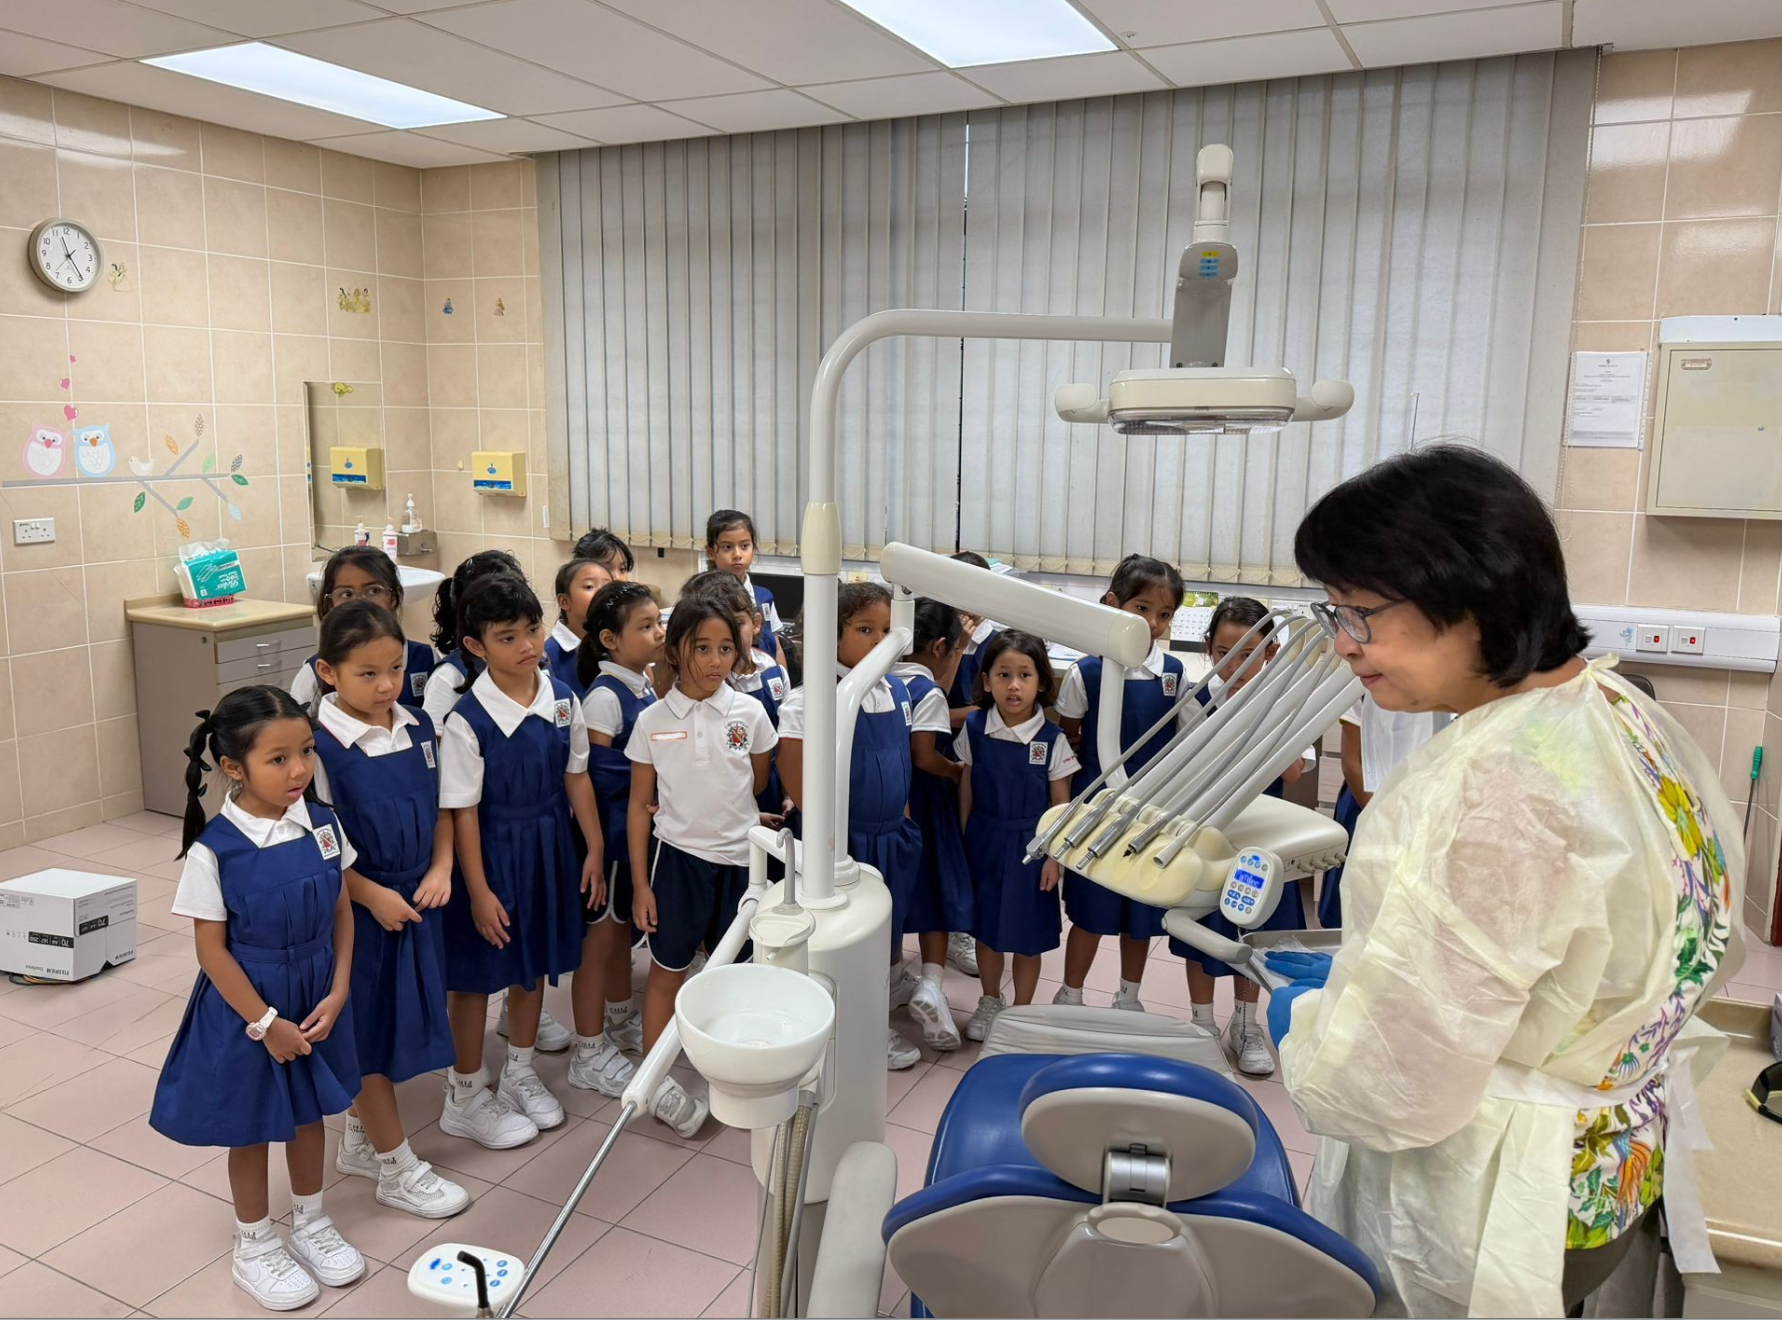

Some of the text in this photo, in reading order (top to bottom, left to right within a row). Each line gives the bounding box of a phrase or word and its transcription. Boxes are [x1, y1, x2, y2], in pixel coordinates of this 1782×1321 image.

[52, 229, 58, 237] 11
[63, 227, 70, 235] 12
[43, 237, 51, 245] 10
[61, 939, 69, 947] 70
[46, 968, 69, 976] FUJIFILM
